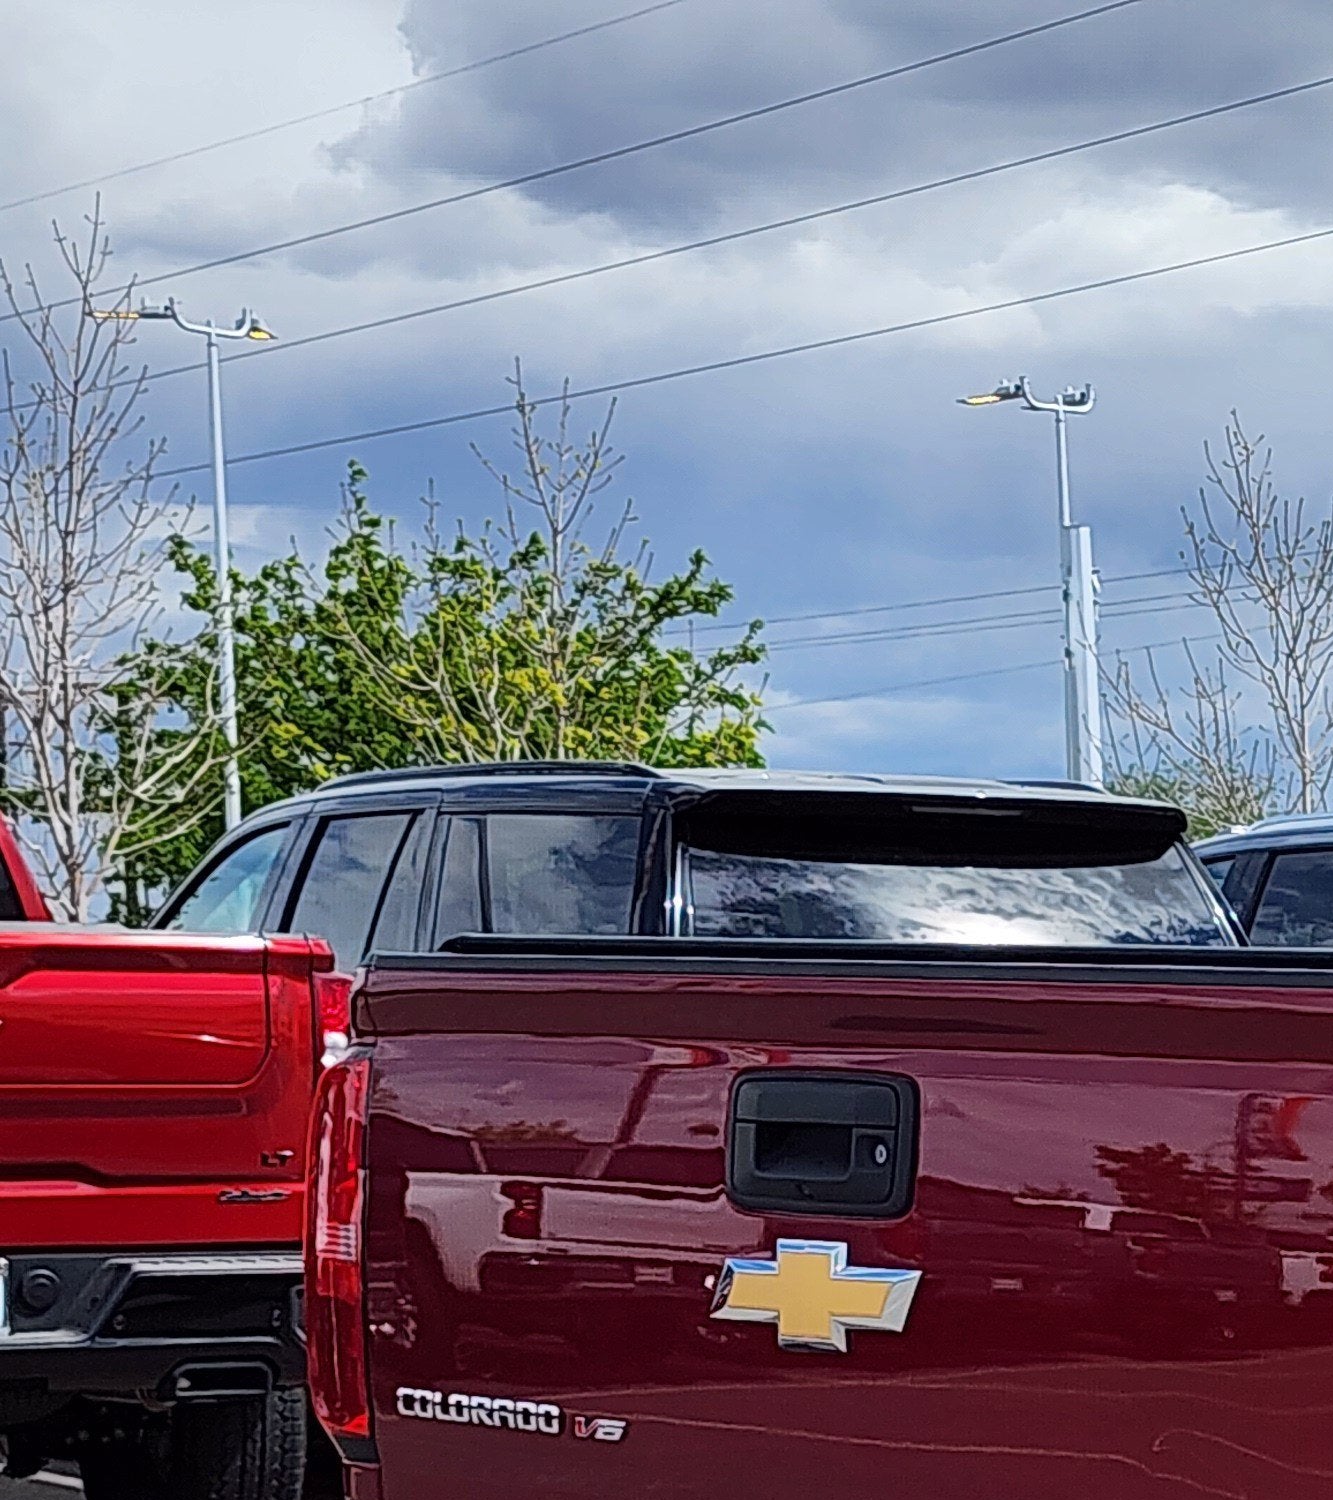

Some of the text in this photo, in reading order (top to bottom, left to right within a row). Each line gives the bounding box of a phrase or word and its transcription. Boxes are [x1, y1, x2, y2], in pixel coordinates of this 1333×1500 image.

[261, 1149, 294, 1168] LT
[396, 1382, 627, 1442] COLORADO V6
